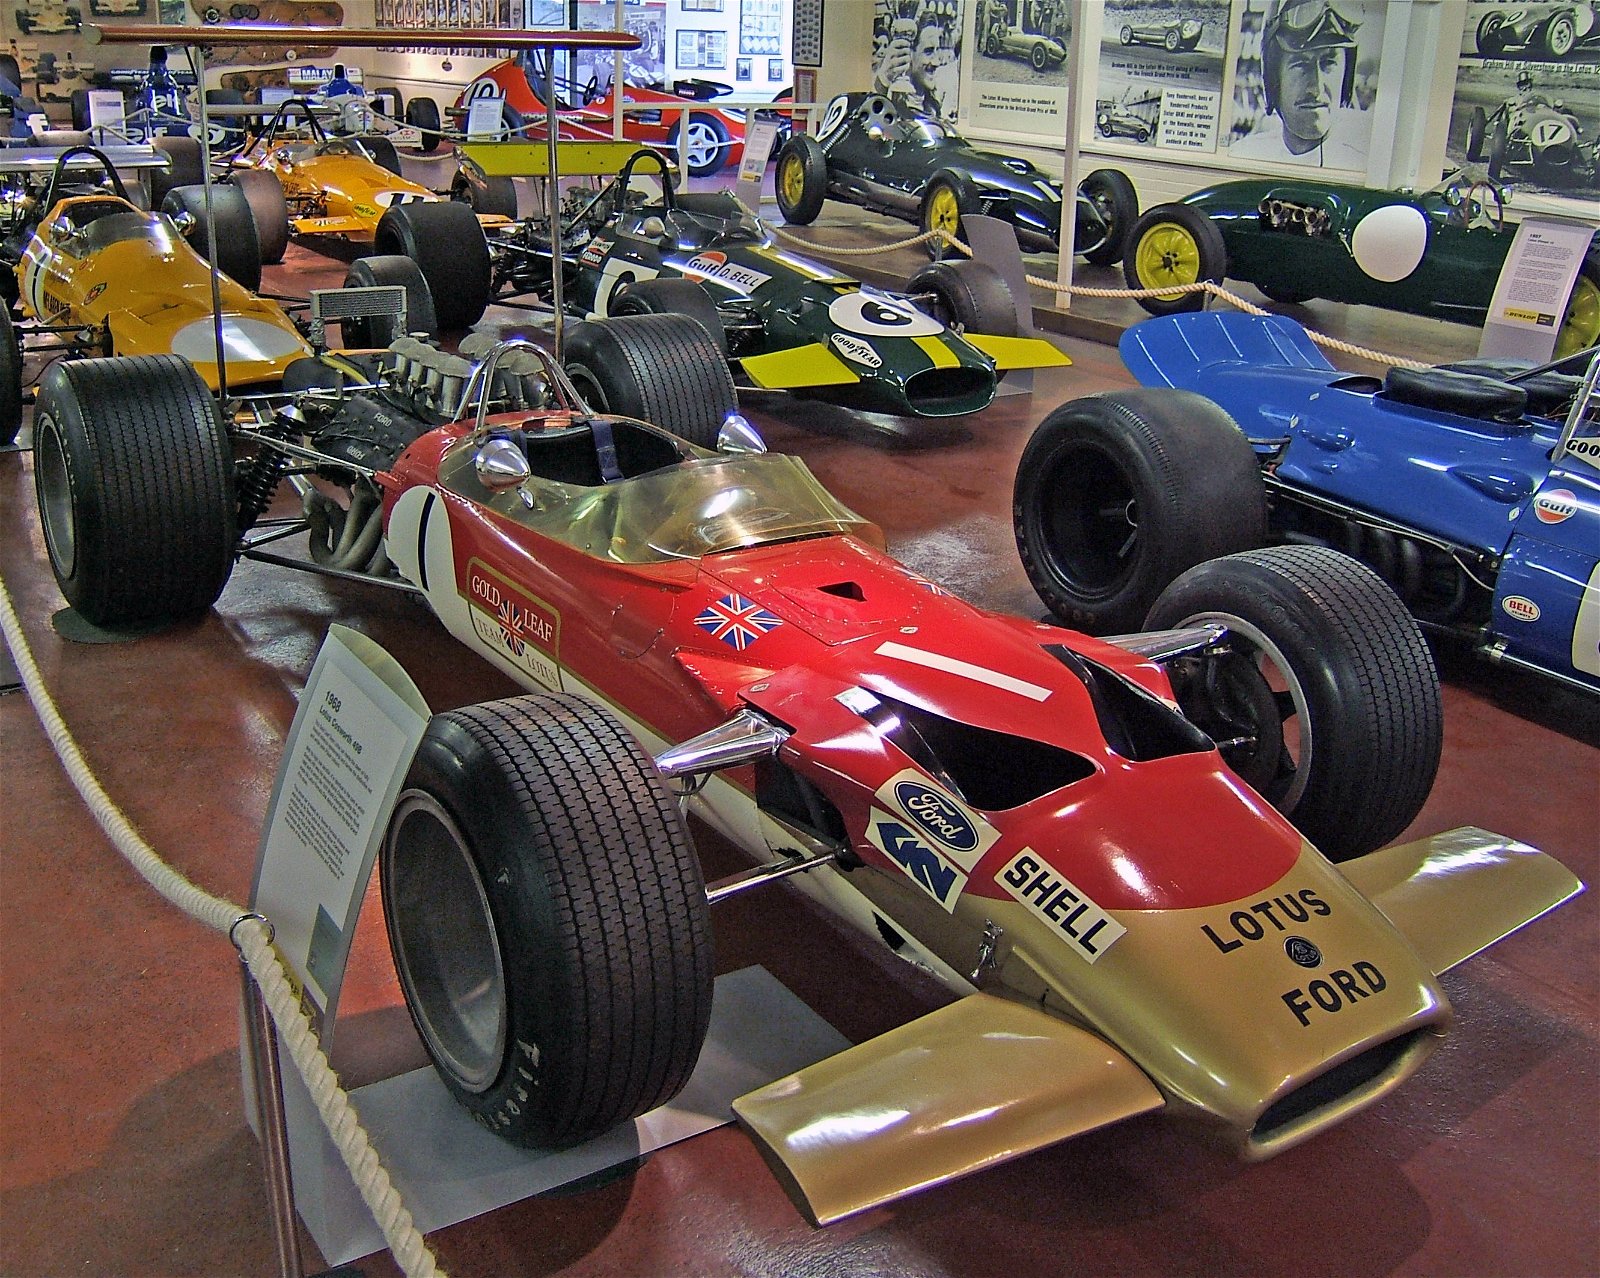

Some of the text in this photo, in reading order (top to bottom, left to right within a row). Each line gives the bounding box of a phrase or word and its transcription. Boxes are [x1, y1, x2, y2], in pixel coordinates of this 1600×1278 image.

[302, 69, 333, 80] MALAY
[1540, 124, 1563, 144] 17
[688, 258, 722, 278] Gulf
[732, 270, 760, 287] BELL
[1509, 312, 1536, 320] DUNLOP
[833, 334, 881, 367] GOODYEAR
[1538, 498, 1573, 516] Gulf
[418, 492, 436, 592] 1
[472, 575, 552, 642] GOLD LEAF
[1509, 600, 1534, 616] BELL
[526, 654, 558, 688] LOTUS
[326, 690, 342, 712] 1968
[320, 704, 332, 722] Lotus
[332, 718, 352, 744] Cosworth
[908, 792, 963, 840] Ford
[1004, 855, 1108, 955] SHELL
[1200, 889, 1332, 954] LOTUS
[1281, 960, 1387, 1027] FORD
